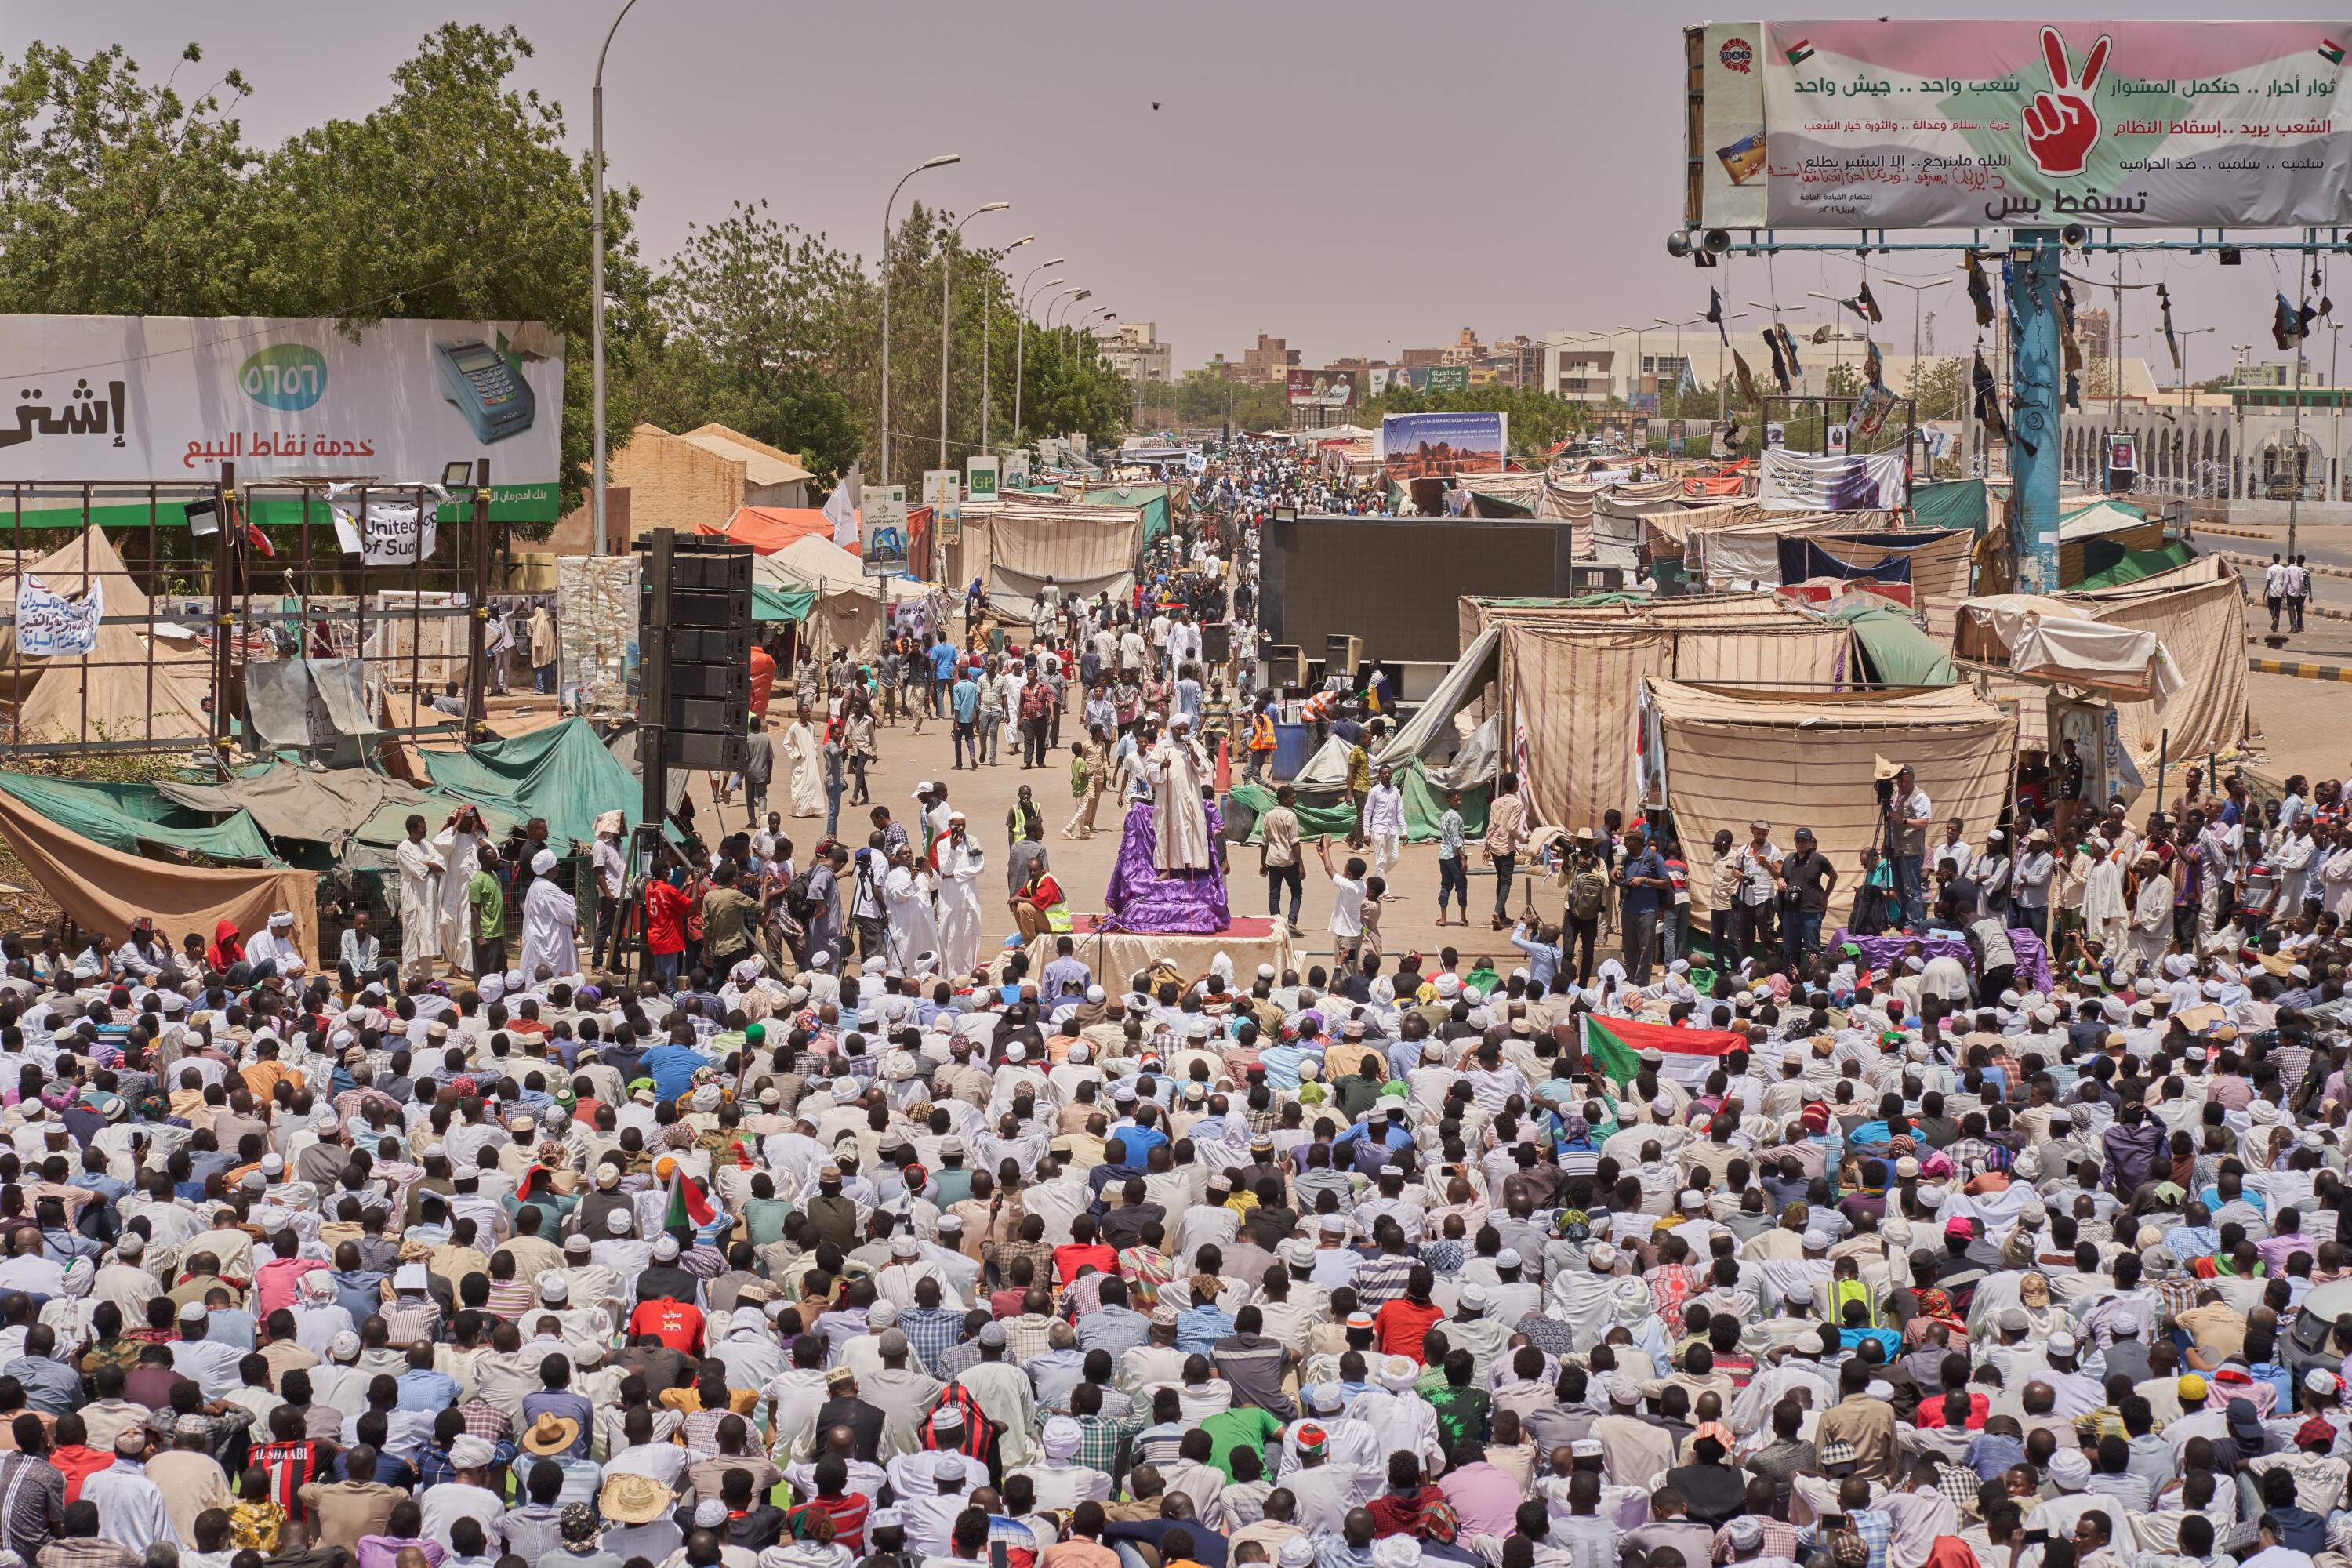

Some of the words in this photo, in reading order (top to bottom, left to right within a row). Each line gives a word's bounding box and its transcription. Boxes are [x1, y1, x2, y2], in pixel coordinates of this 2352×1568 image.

[1794, 76, 1835, 96] واحد
[1843, 74, 1891, 97] جيش
[1920, 77, 1961, 96] واحد
[1969, 74, 2020, 96] شعب
[2111, 77, 2176, 97] المشوار
[2183, 78, 2240, 98] حنكمل
[2266, 74, 2300, 97] أحرار
[2307, 78, 2336, 97] ثوار
[1804, 120, 1840, 132] الشعب
[1844, 121, 1861, 132] خيار
[1865, 119, 1898, 132] والثورة
[1913, 121, 1947, 132] وعدالة
[1989, 120, 2011, 132] حرية
[2114, 120, 2162, 136] النظام
[2240, 125, 2270, 138] يريد
[2276, 118, 2331, 137] الشعب
[1804, 155, 1842, 173] يطلع
[1845, 153, 1885, 170] البشير
[1890, 155, 1905, 170] إلا
[2120, 158, 2170, 172] الحراميه
[2176, 158, 2197, 170] ضد
[2218, 158, 2261, 171] سلميه
[2282, 158, 2324, 171] سلميه
[1849, 194, 1873, 203] إعتصام
[2053, 188, 2148, 219] تسقط
[1984, 196, 2042, 222] بس
[245, 364, 319, 396] ٥٦٥٦
[183, 433, 241, 468] البيع
[249, 431, 306, 457] نقاط
[313, 434, 375, 457] خدمة
[972, 476, 994, 488] GP
[499, 490, 531, 503] امدرمان
[532, 489, 546, 501] بنك
[365, 539, 382, 554] of
[649, 898, 658, 916] 5
[253, 1449, 265, 1461] AL
[267, 1447, 308, 1460] SHAABI
[267, 1461, 286, 1507] 1
